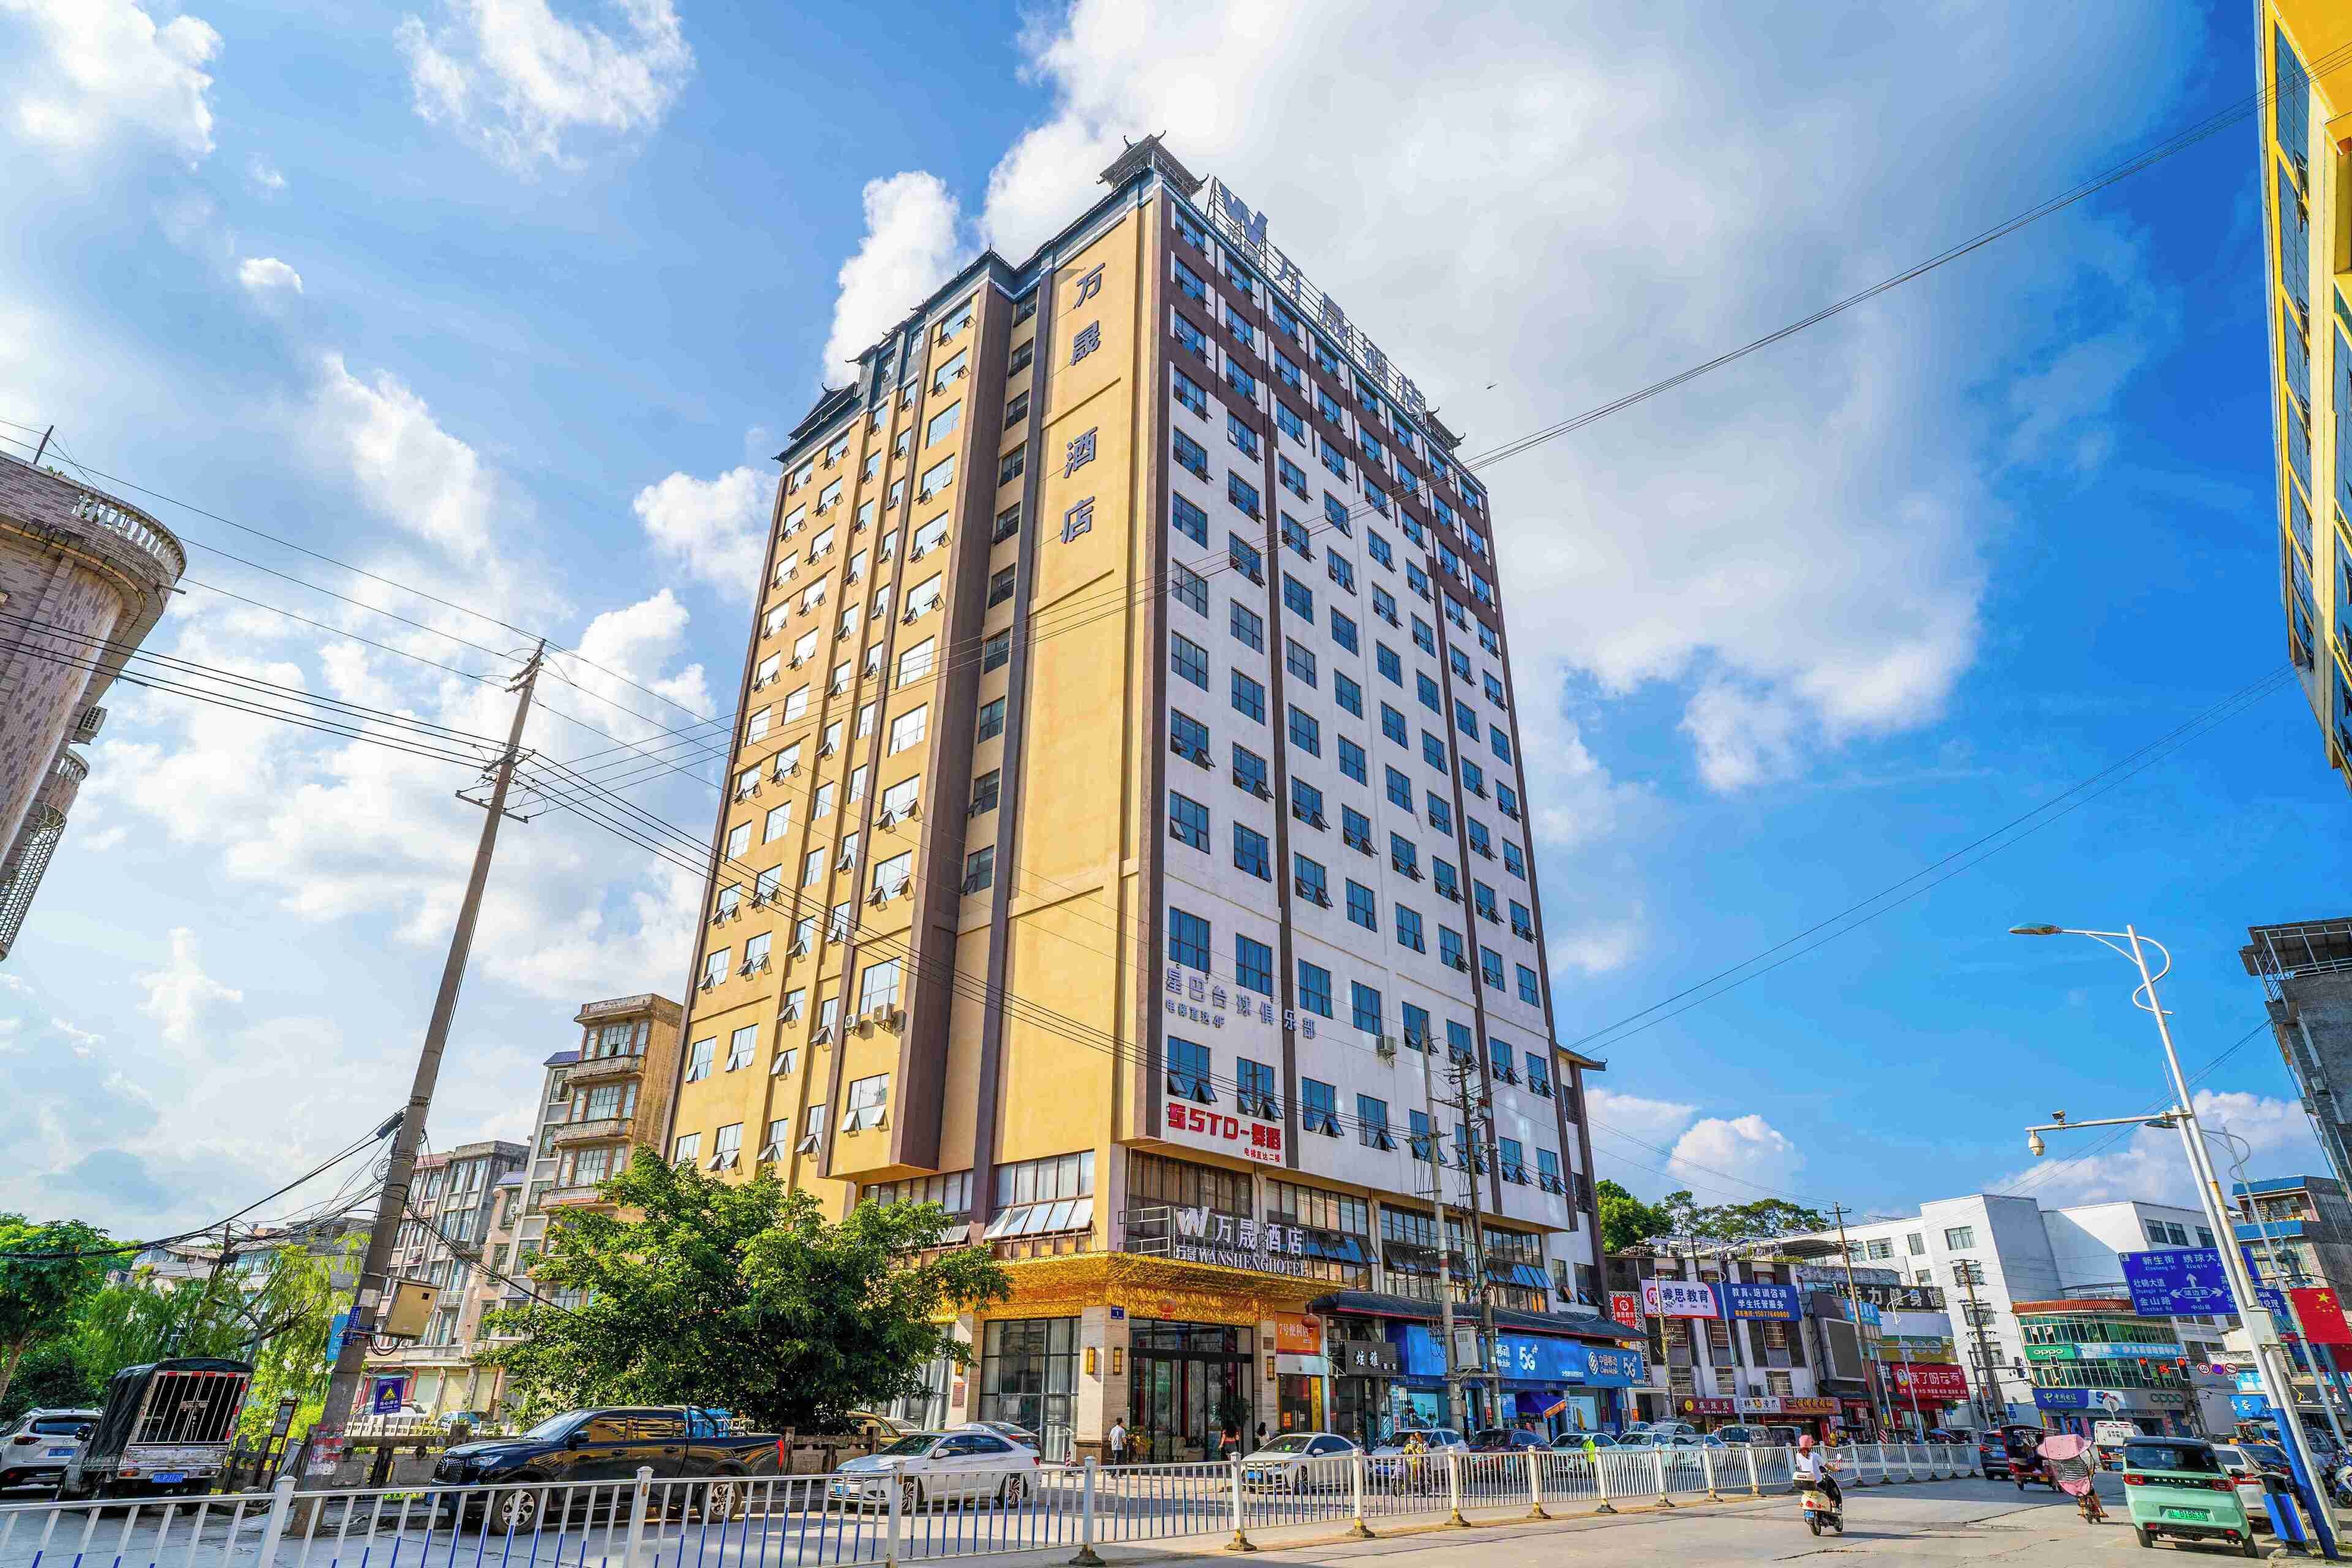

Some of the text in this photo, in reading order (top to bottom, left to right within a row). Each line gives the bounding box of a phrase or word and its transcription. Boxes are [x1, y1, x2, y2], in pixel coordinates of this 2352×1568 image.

[1060, 262, 1106, 544] 万晟酒店
[1166, 967, 1316, 1039] 星巴台球俱乐部
[1215, 1215, 1303, 1255] 万晟酒店
[2143, 1252, 2218, 1265] 新生街 绣球大
[1662, 1288, 1708, 1303] 睿思教育
[2139, 1296, 2172, 1306] 金山路
